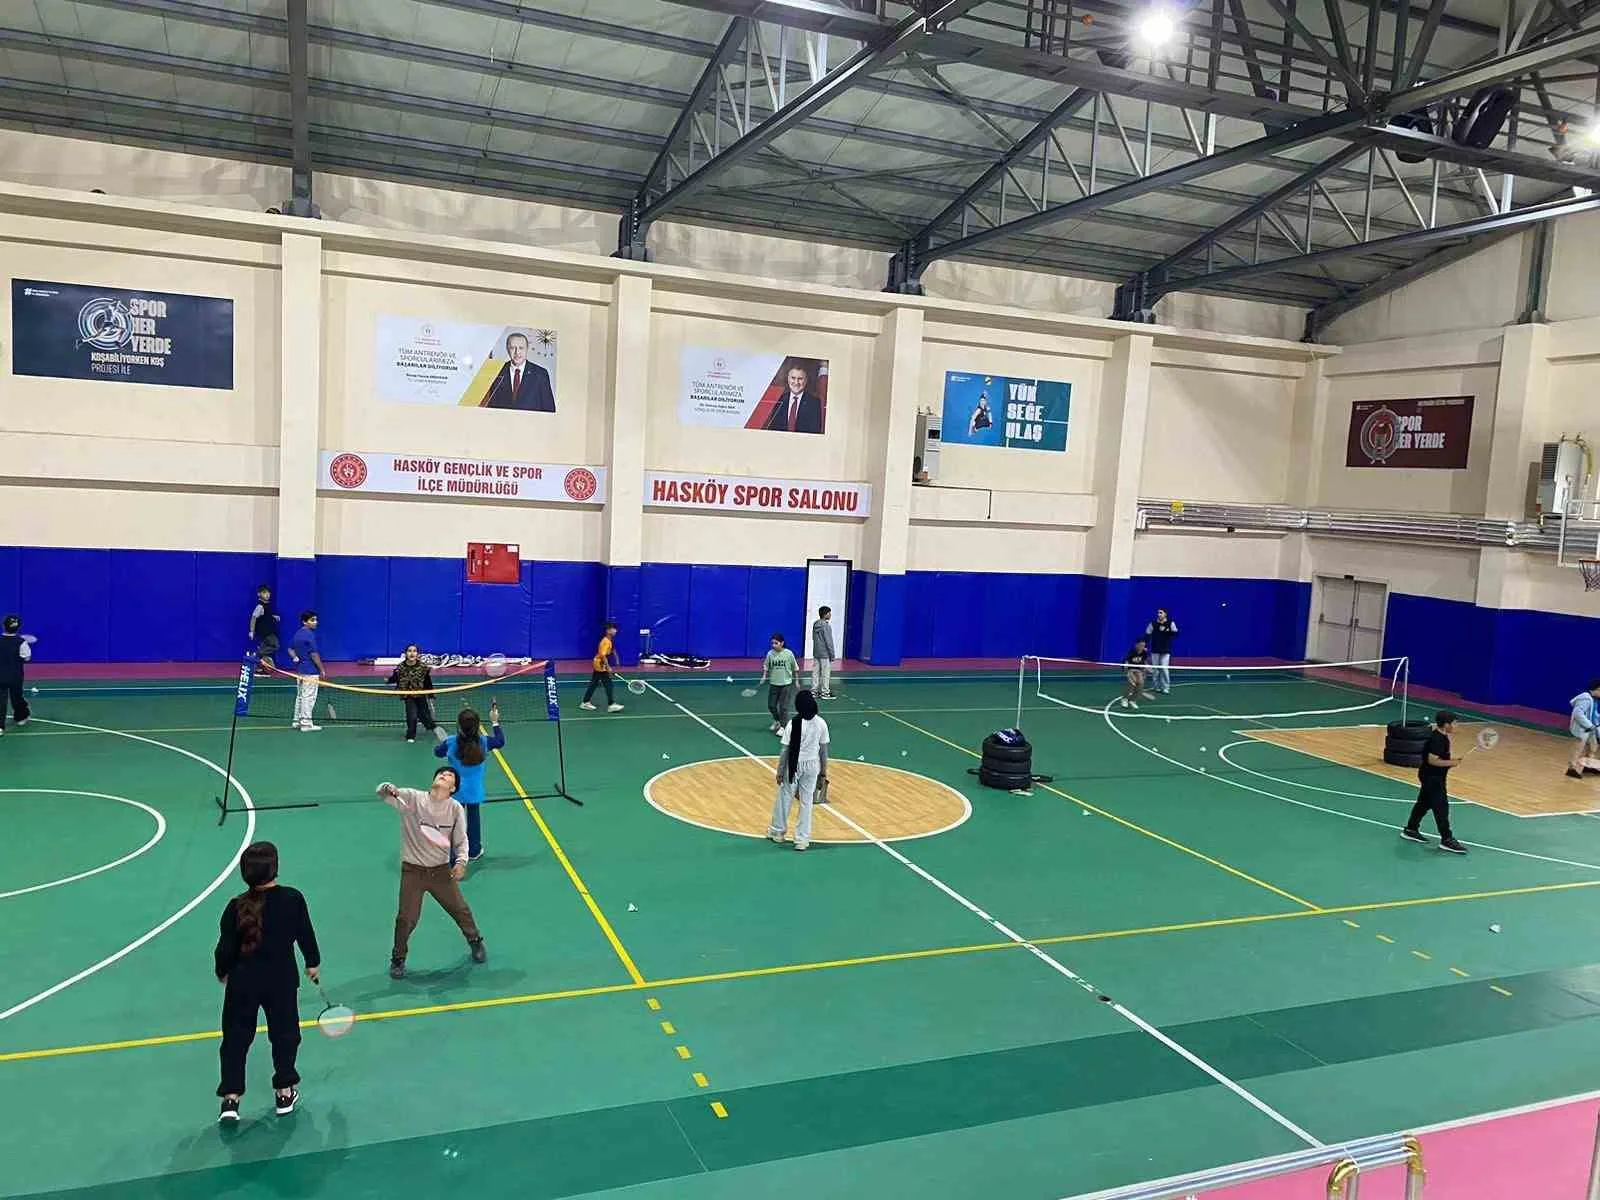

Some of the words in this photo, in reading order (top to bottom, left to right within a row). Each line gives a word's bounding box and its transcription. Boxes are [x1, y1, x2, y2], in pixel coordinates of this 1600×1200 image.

[129, 298, 167, 318] SPOR
[131, 335, 172, 355] YERDE
[150, 356, 165, 367] KOŞ
[1006, 422, 1043, 442] ULAŞ
[1414, 432, 1445, 448] YERDE
[393, 458, 440, 474] HASKÖY
[443, 461, 492, 477] GENÇLİK
[496, 466, 509, 478] VE
[512, 467, 543, 480] SPOR
[417, 475, 443, 493] İLÇE
[447, 479, 519, 496] MÜDÜRLÜĞÜ
[653, 479, 728, 504] HASKÖY
[733, 484, 782, 507] SPOR
[787, 488, 859, 512] SALONU
[237, 664, 250, 703] HELIX
[547, 676, 557, 705] HELIX
